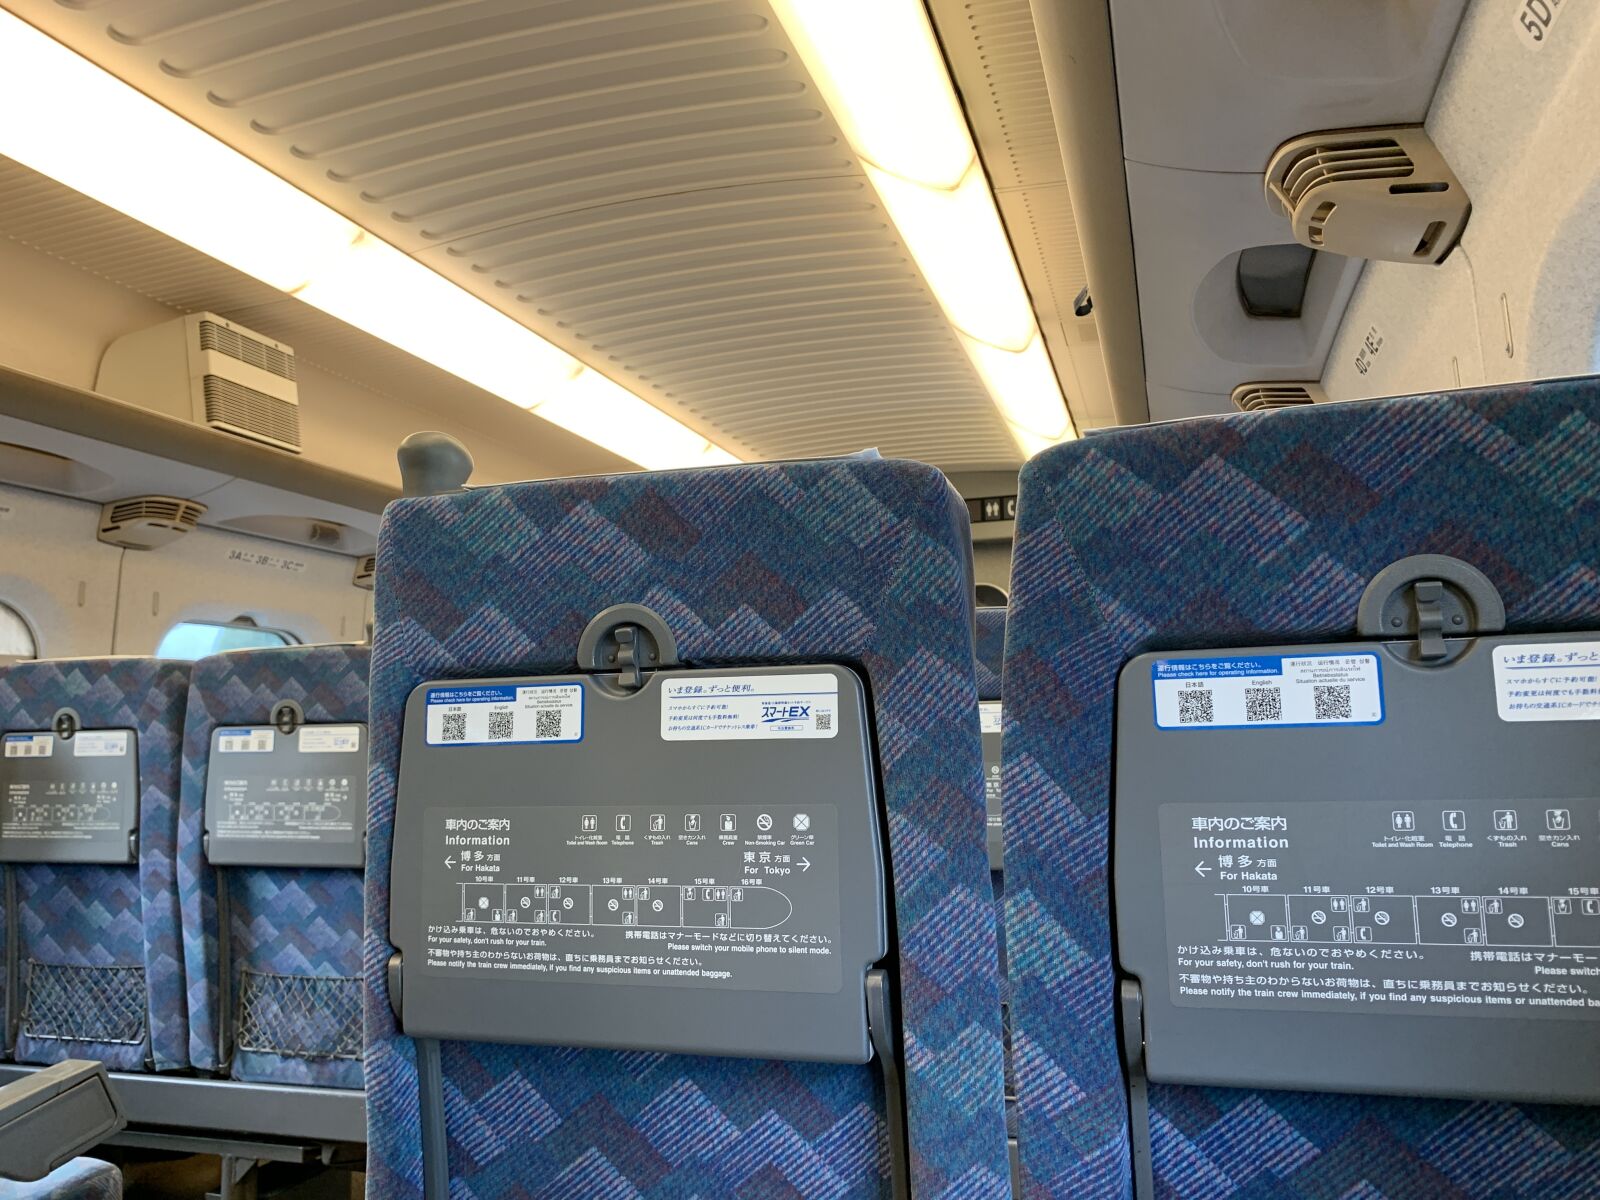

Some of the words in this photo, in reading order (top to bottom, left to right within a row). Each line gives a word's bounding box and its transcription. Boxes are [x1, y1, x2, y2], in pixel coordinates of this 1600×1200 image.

[1520, 0, 1552, 41] 5D
[1157, 662, 1262, 672] 運行情報はこちらをご覧ください。
[762, 706, 810, 718] スマートEX
[445, 819, 510, 831] 車内のご案内
[1191, 816, 1288, 831] 車内のご案内
[446, 835, 510, 846] Information
[1193, 836, 1289, 849] Information
[774, 855, 791, 863] 方面
[1257, 859, 1277, 868] 方面
[744, 866, 758, 874] For
[764, 866, 791, 876] Tokyo
[1220, 872, 1238, 880] For
[1241, 872, 1278, 880] Hakata
[1366, 886, 1394, 894] 12号車
[1498, 887, 1528, 895] 14号車
[1568, 887, 1599, 896] 15号車
[428, 926, 595, 937] かけ込み乗車は、危ないのでおやめください。
[625, 930, 832, 944] 携帯電話はマナーモードなどに切り替えてください。
[454, 936, 472, 945] safety,
[668, 943, 689, 951] Please
[756, 945, 778, 954] phone
[788, 946, 808, 954] silent
[1177, 945, 1424, 960] かけ込み乗車は、危ないのでおやめください。
[428, 948, 702, 966] 不審物や持ち主のわからないお荷物は、直ちに乗務員までお知らせください。
[1470, 951, 1598, 963] 携帯電話はマナーモー
[448, 960, 465, 969] notify
[510, 962, 548, 972] immediately,
[596, 966, 631, 975] suspicious
[633, 967, 651, 975] items
[662, 968, 699, 976] unattended
[701, 969, 733, 978] baggage.
[1216, 958, 1244, 968] safety,
[1246, 959, 1268, 968] don't
[1293, 961, 1306, 969] for
[1331, 962, 1354, 970] train.
[1535, 966, 1567, 975] Please
[1179, 973, 1588, 994] 不審物や持ち主のわからないお荷物は、直ちに乗務員までお知らせください。
[1180, 987, 1208, 996] Please
[1211, 987, 1235, 997] notify
[1238, 988, 1252, 996] the
[1254, 989, 1274, 997] train
[1301, 990, 1358, 1001] immediately,
[1369, 994, 1386, 1002] you
[1388, 993, 1407, 1001] find
[1430, 994, 1482, 1004] suspicious
[1485, 996, 1511, 1005] items
[1529, 997, 1585, 1006] unattended
